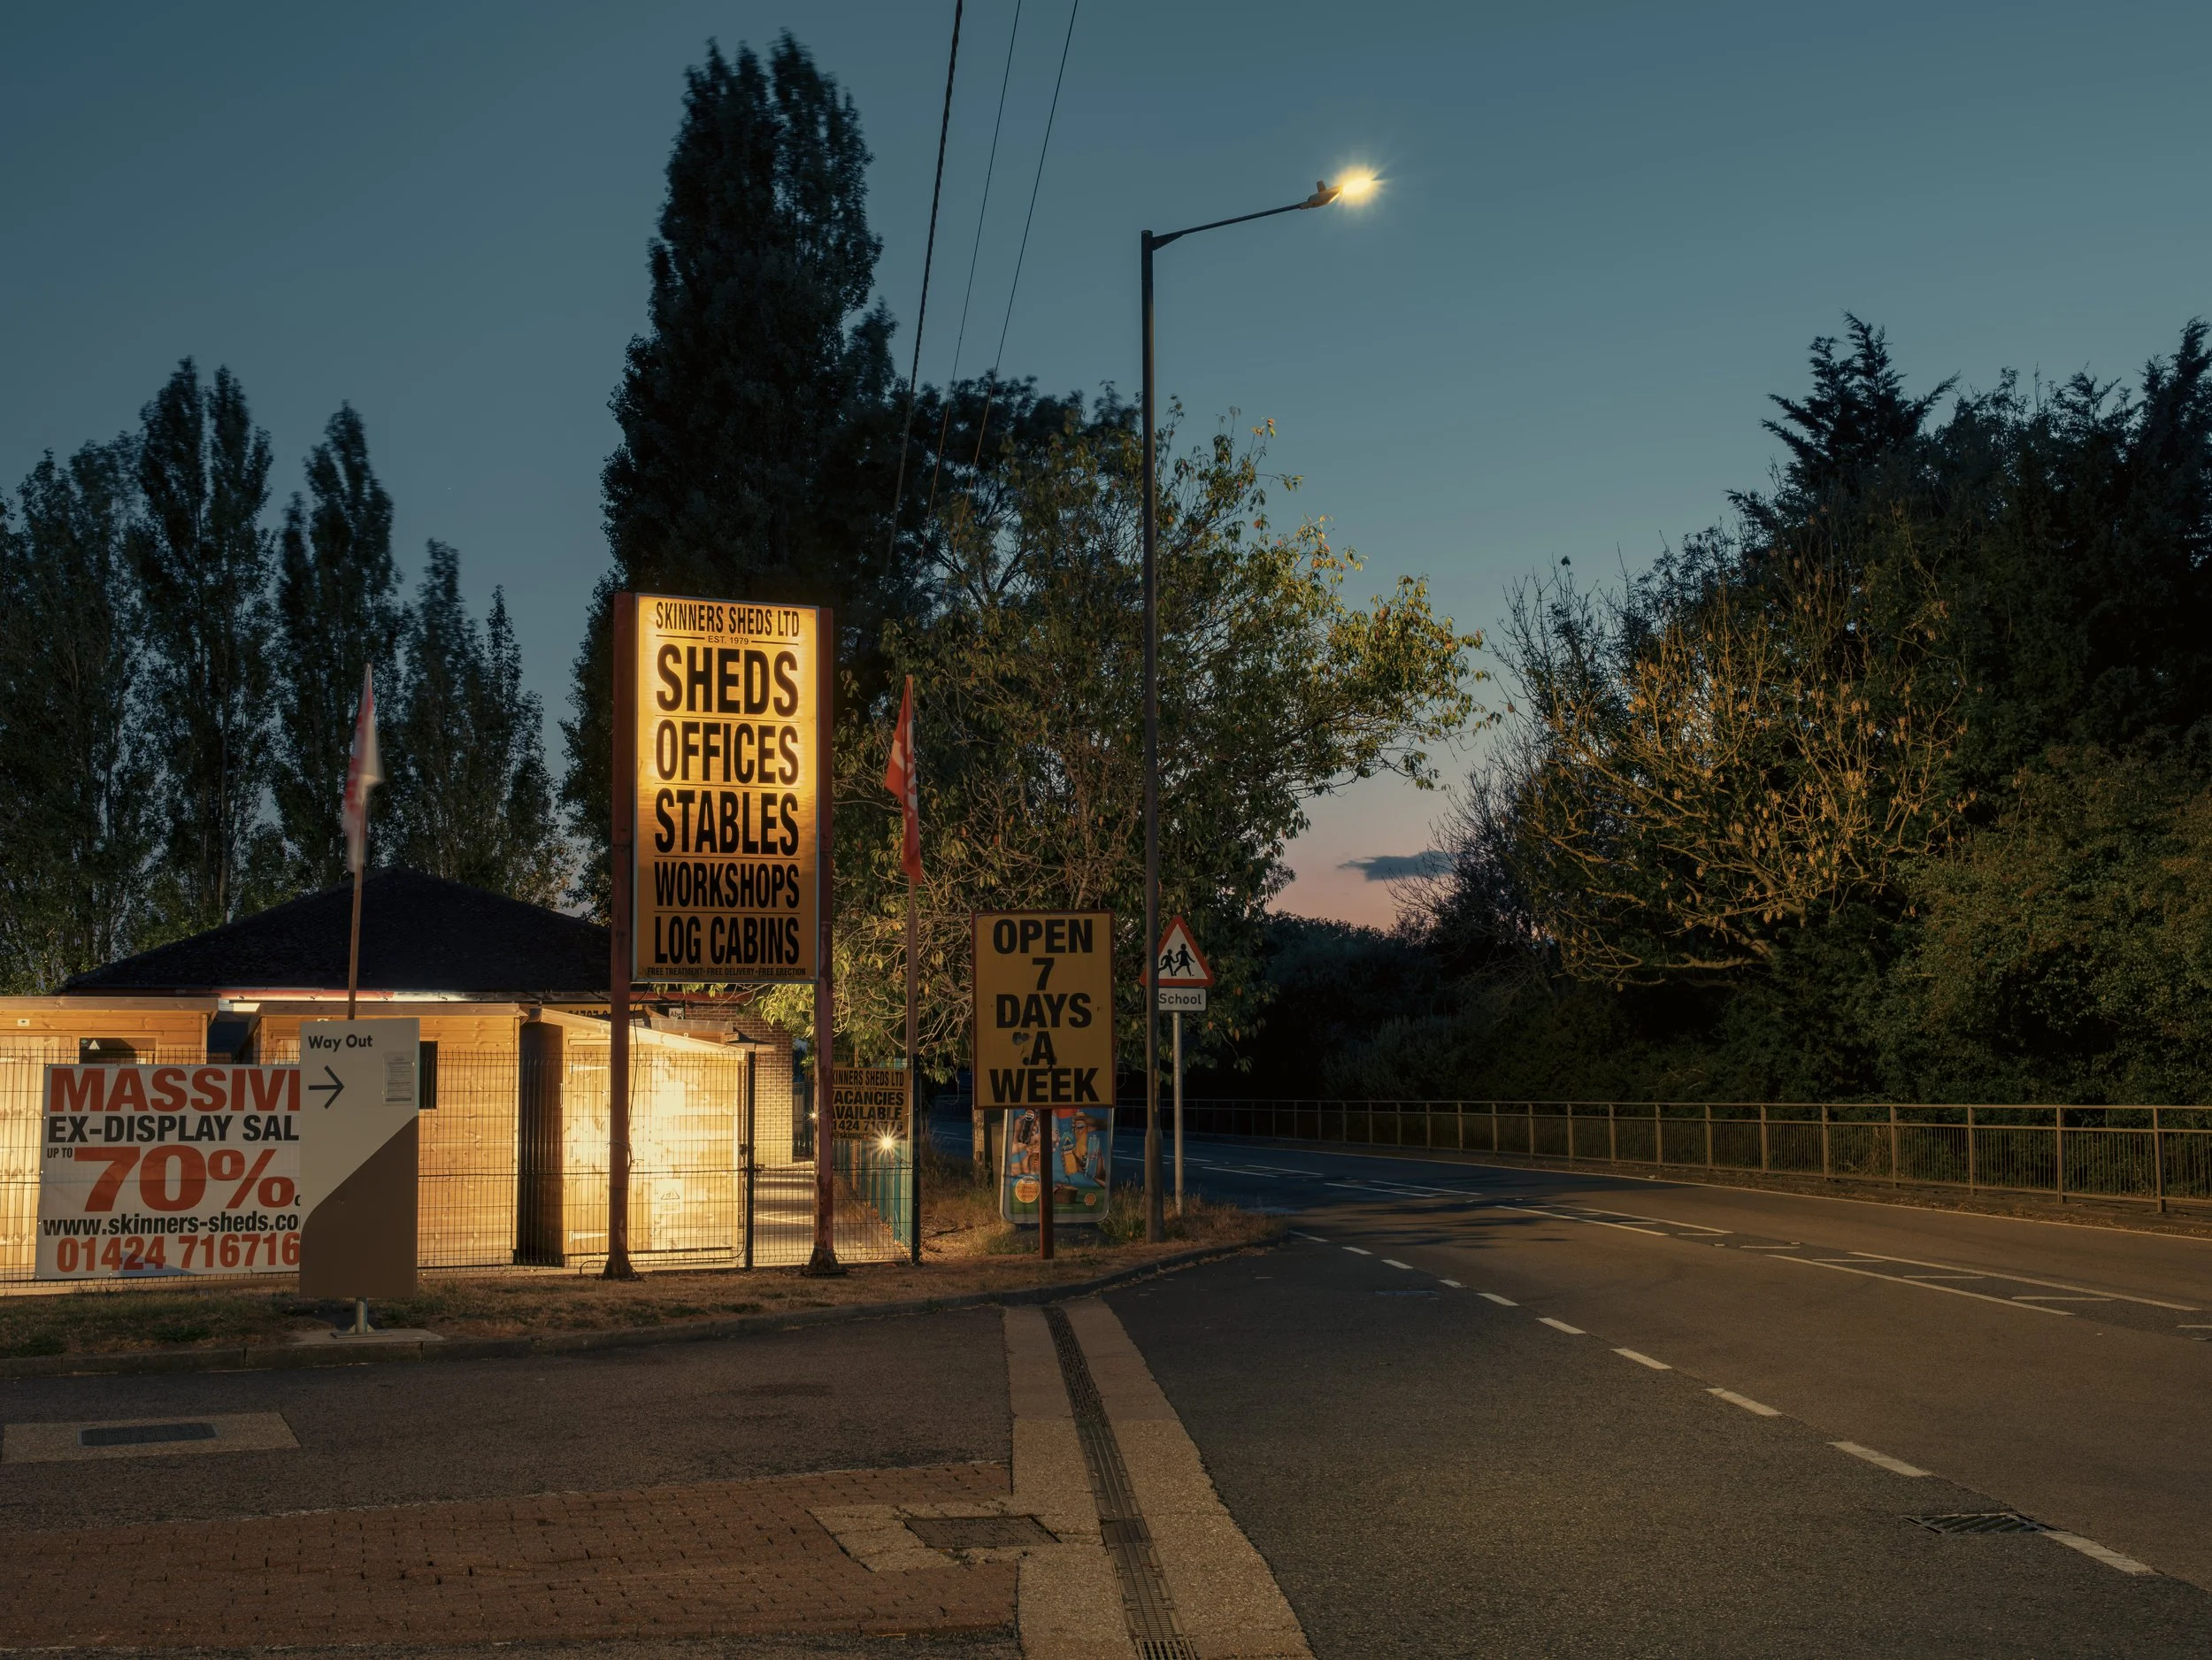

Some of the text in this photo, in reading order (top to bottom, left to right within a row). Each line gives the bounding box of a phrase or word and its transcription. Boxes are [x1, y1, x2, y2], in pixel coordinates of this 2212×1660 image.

[656, 601, 800, 637] SKINNERS SHEDS LTD
[707, 635, 726, 644] EST.
[656, 643, 799, 718] SHEDS
[656, 719, 799, 785] OFFICES
[655, 788, 799, 857] STABLES
[654, 862, 800, 909] WORKSHOPS
[655, 916, 800, 964] LOG CABINS
[993, 918, 1094, 954] OPEN
[647, 967, 664, 976] FREE
[707, 967, 723, 976] FREE
[758, 967, 774, 976] FREE
[776, 967, 806, 976] ERECTION
[1032, 957, 1055, 990] 7
[996, 993, 1093, 1028] DAYS
[1159, 993, 1202, 1004] School
[308, 1034, 373, 1052] Way Out
[1031, 1031, 1056, 1065] A
[865, 1071, 889, 1086] SHEDS
[891, 1072, 904, 1087] LTD
[989, 1068, 1100, 1103] WEEK
[833, 1090, 904, 1106] ACANCIES
[833, 1105, 902, 1120] VAILABLE
[48, 1114, 299, 1142] EX-DISPLAY SAL
[833, 1120, 859, 1131] 1424
[47, 1148, 73, 1159] UP TO
[73, 1146, 295, 1212] 70%
[57, 1232, 300, 1272] 01424 716716
